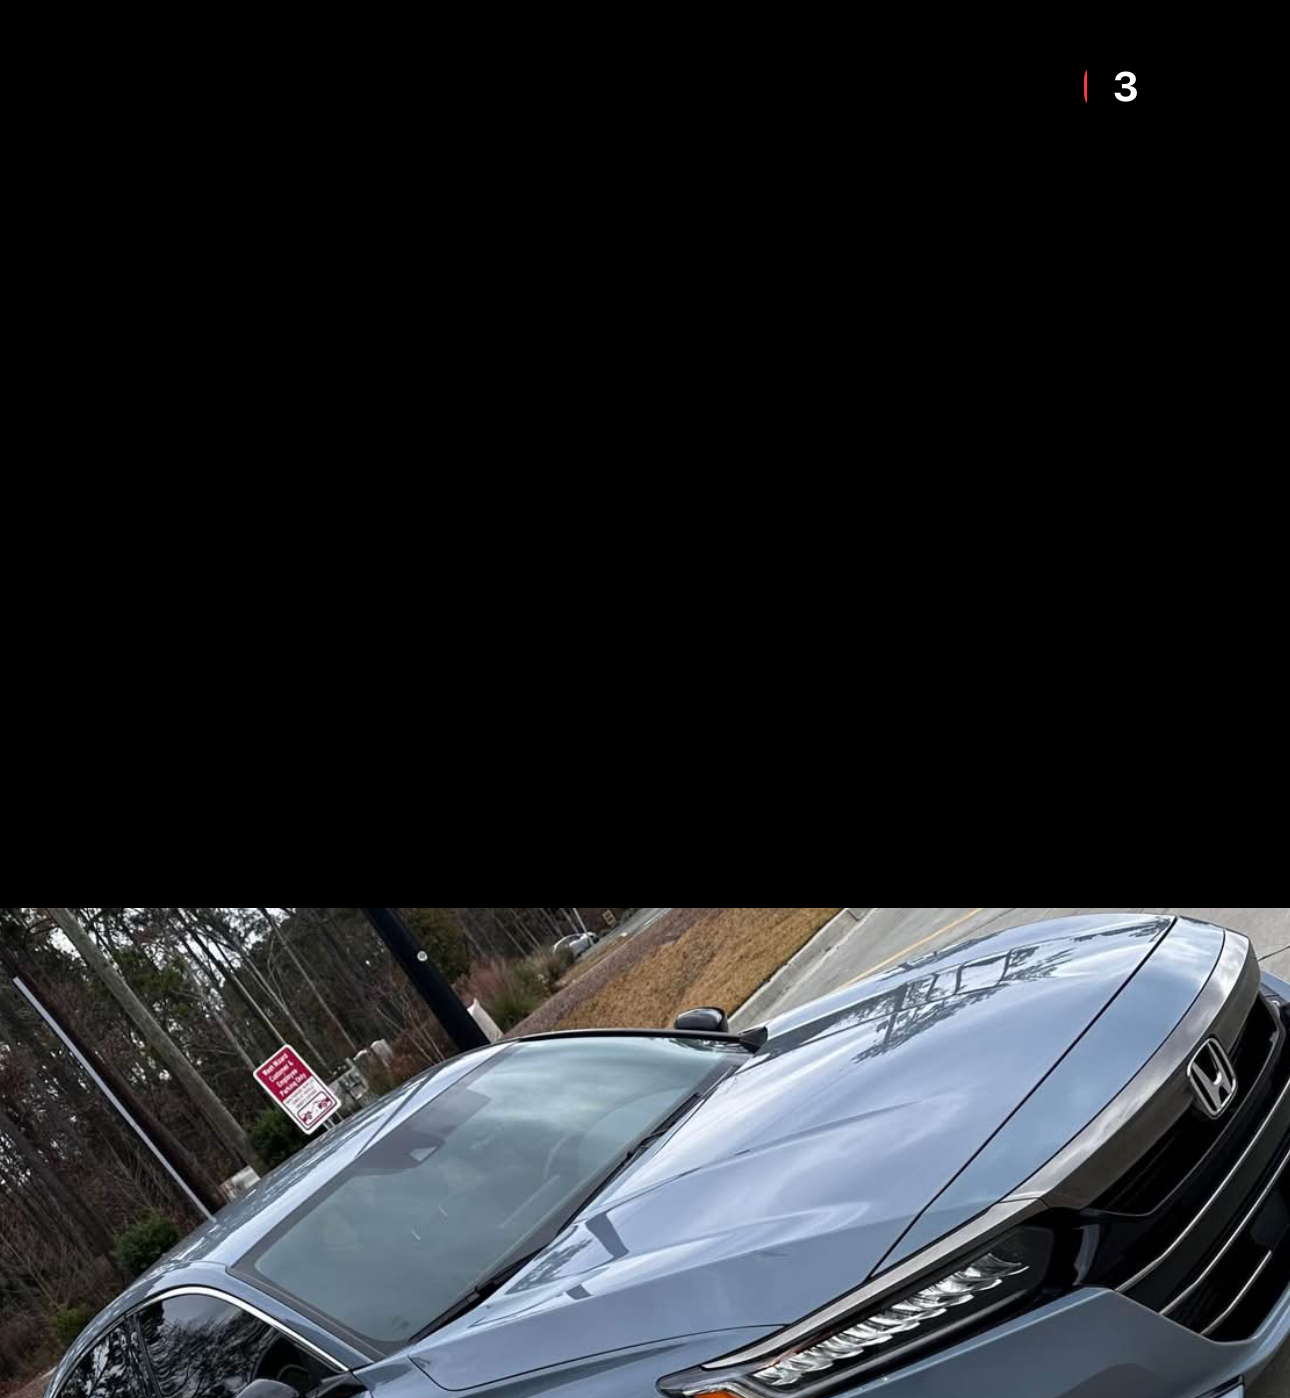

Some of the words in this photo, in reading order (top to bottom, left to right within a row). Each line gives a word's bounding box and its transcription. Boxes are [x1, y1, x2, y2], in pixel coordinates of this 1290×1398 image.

[268, 1063, 290, 1083] Customer
[276, 1069, 298, 1088] Employee
[279, 1080, 298, 1097] Parking
[295, 1073, 307, 1084] Only
